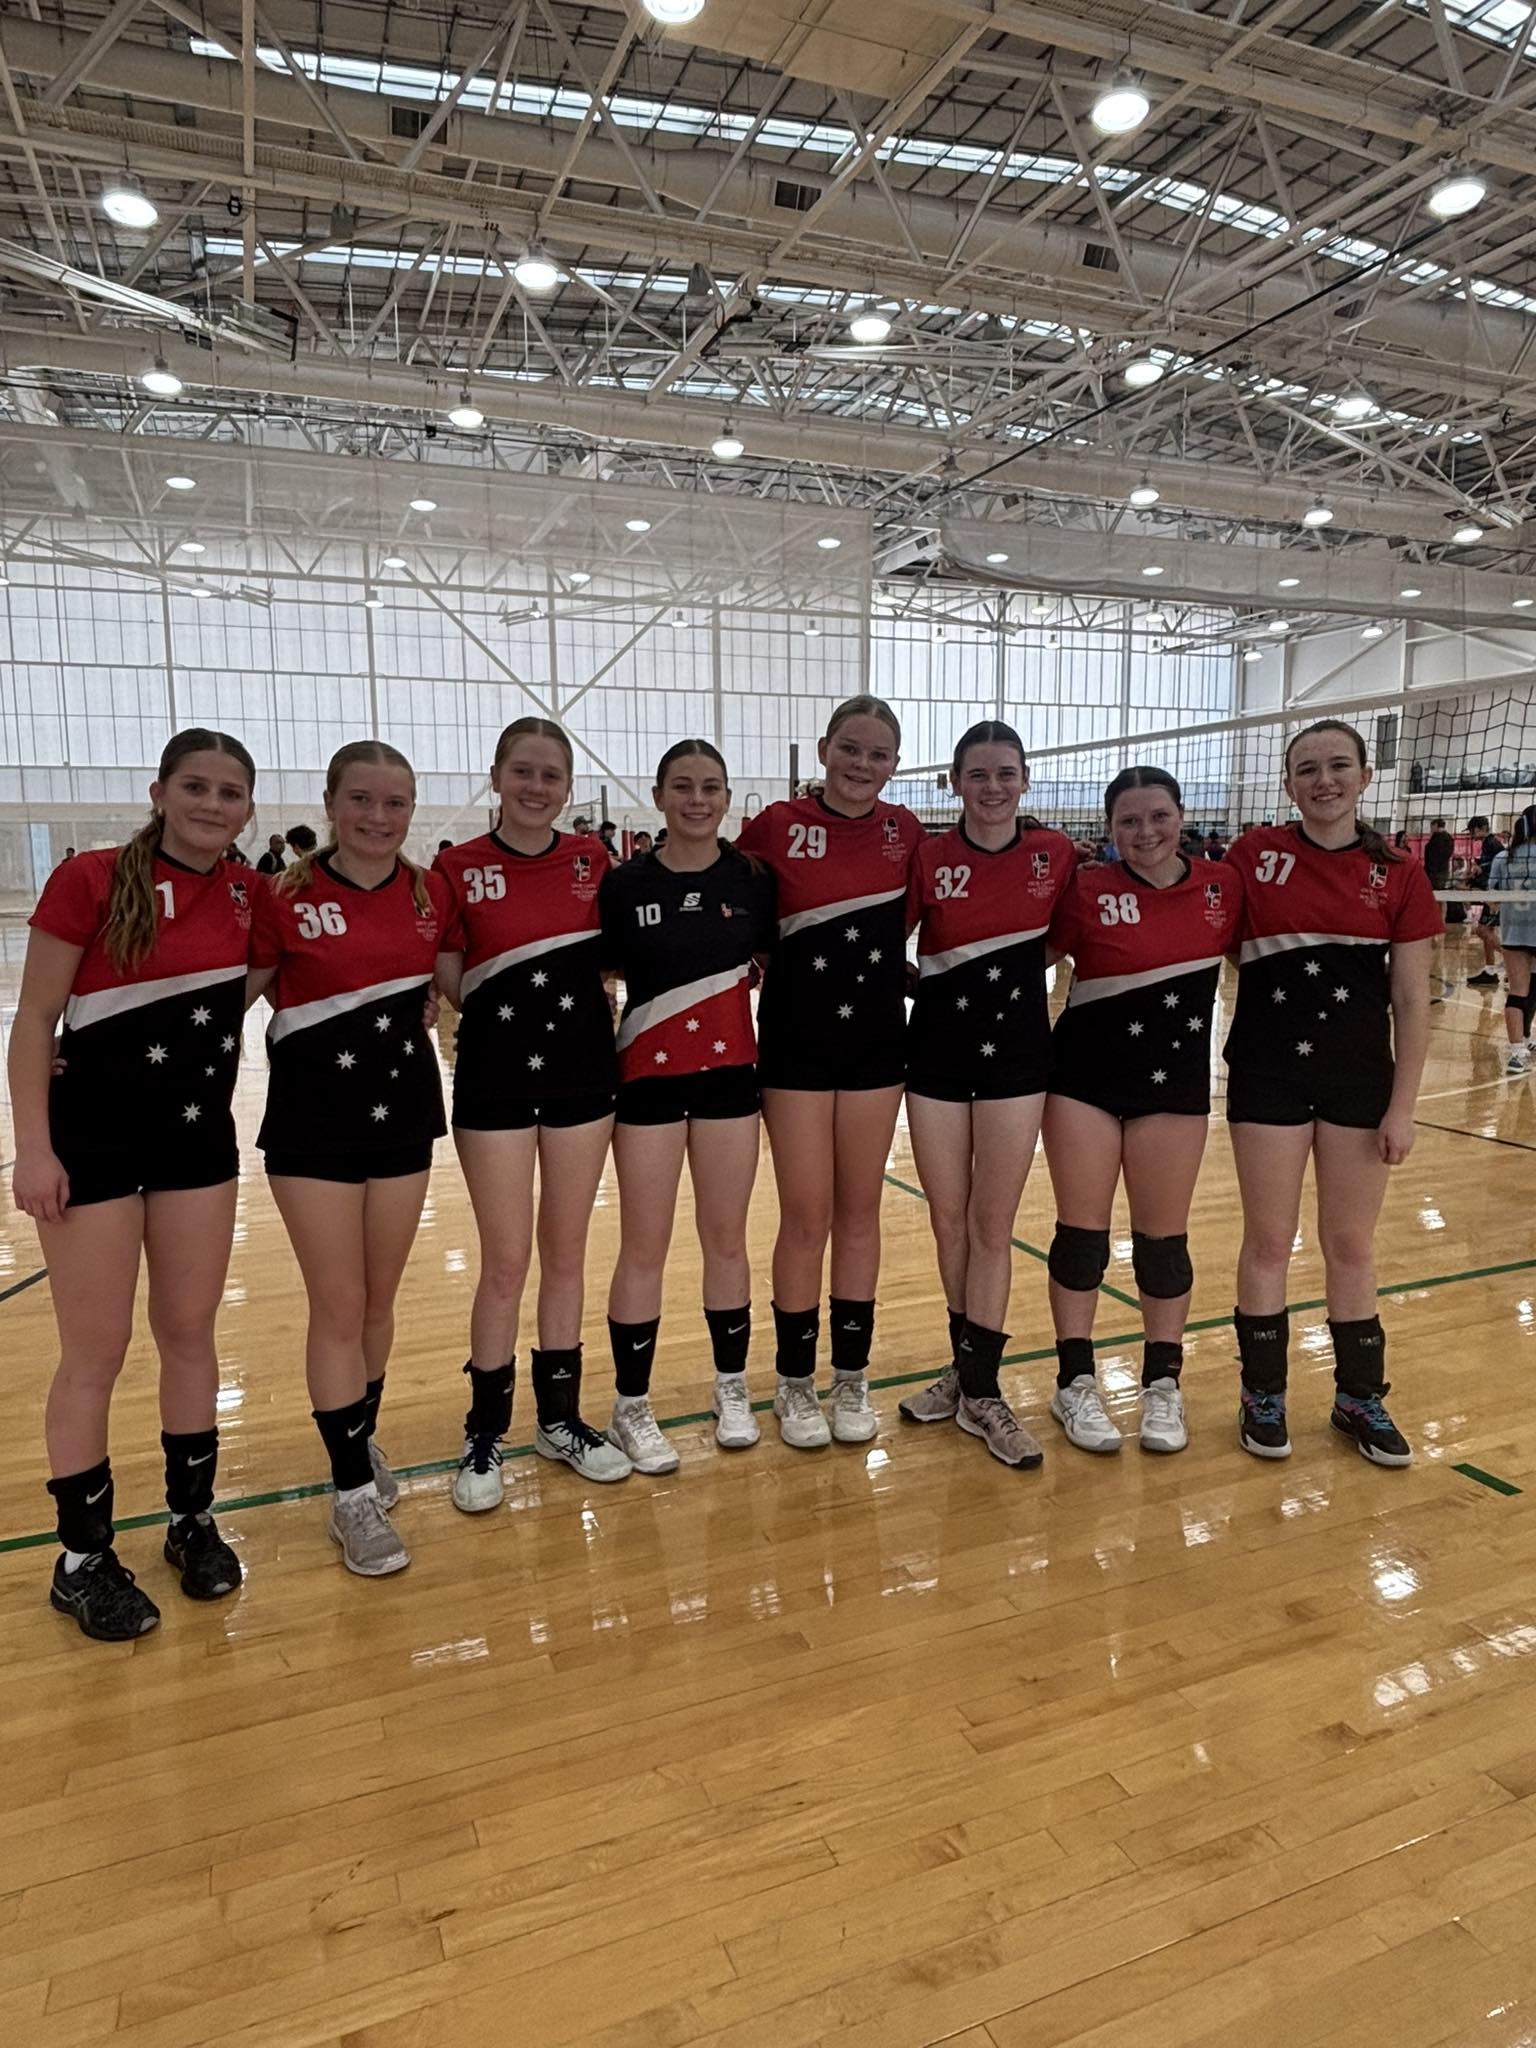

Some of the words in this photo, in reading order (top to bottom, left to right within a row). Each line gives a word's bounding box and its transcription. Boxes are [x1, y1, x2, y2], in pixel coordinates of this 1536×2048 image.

[786, 822, 828, 860] 29
[463, 864, 507, 904] 35
[934, 864, 972, 900] 32
[1254, 849, 1297, 886] 37
[293, 901, 348, 940] 36
[635, 902, 662, 928] 10
[1096, 893, 1142, 926] 38
